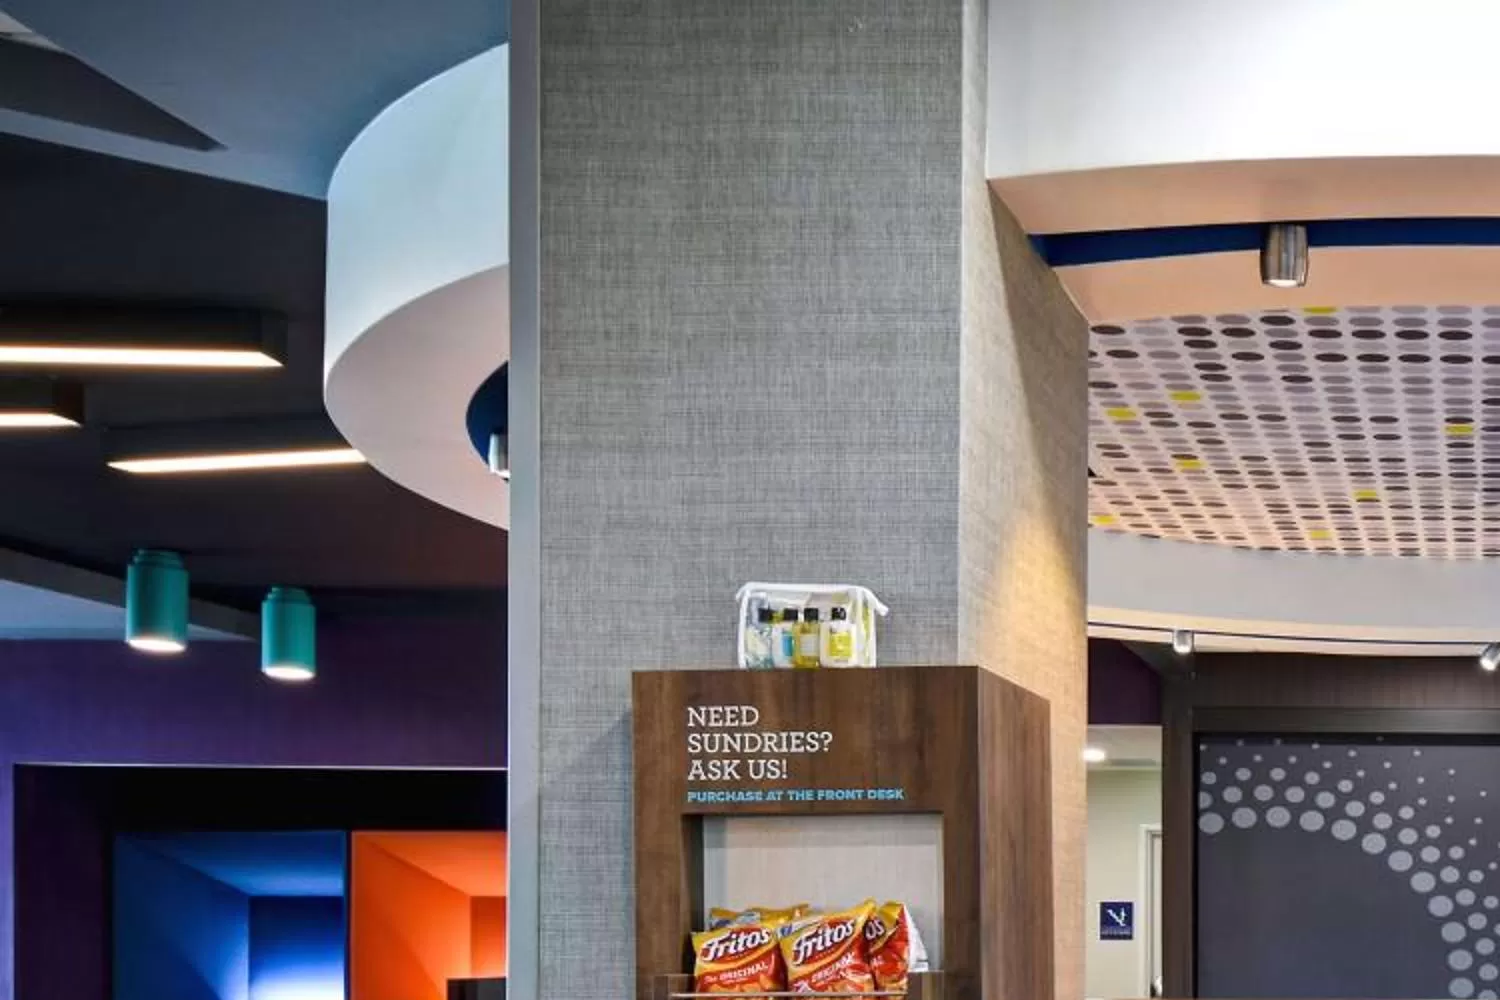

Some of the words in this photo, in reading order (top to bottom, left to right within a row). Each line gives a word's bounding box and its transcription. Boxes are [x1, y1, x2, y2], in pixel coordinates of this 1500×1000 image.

[687, 705, 760, 728] NEED
[687, 732, 833, 754] SUNDRIES?
[687, 760, 741, 781] ASK
[748, 760, 788, 780] US!
[687, 790, 763, 803] PURCHASE
[766, 790, 784, 801] AT
[787, 789, 814, 801] THE
[817, 788, 864, 801] FRONT
[867, 787, 905, 800] DESK
[702, 927, 772, 963] Fritos
[793, 919, 857, 967] Fritos
